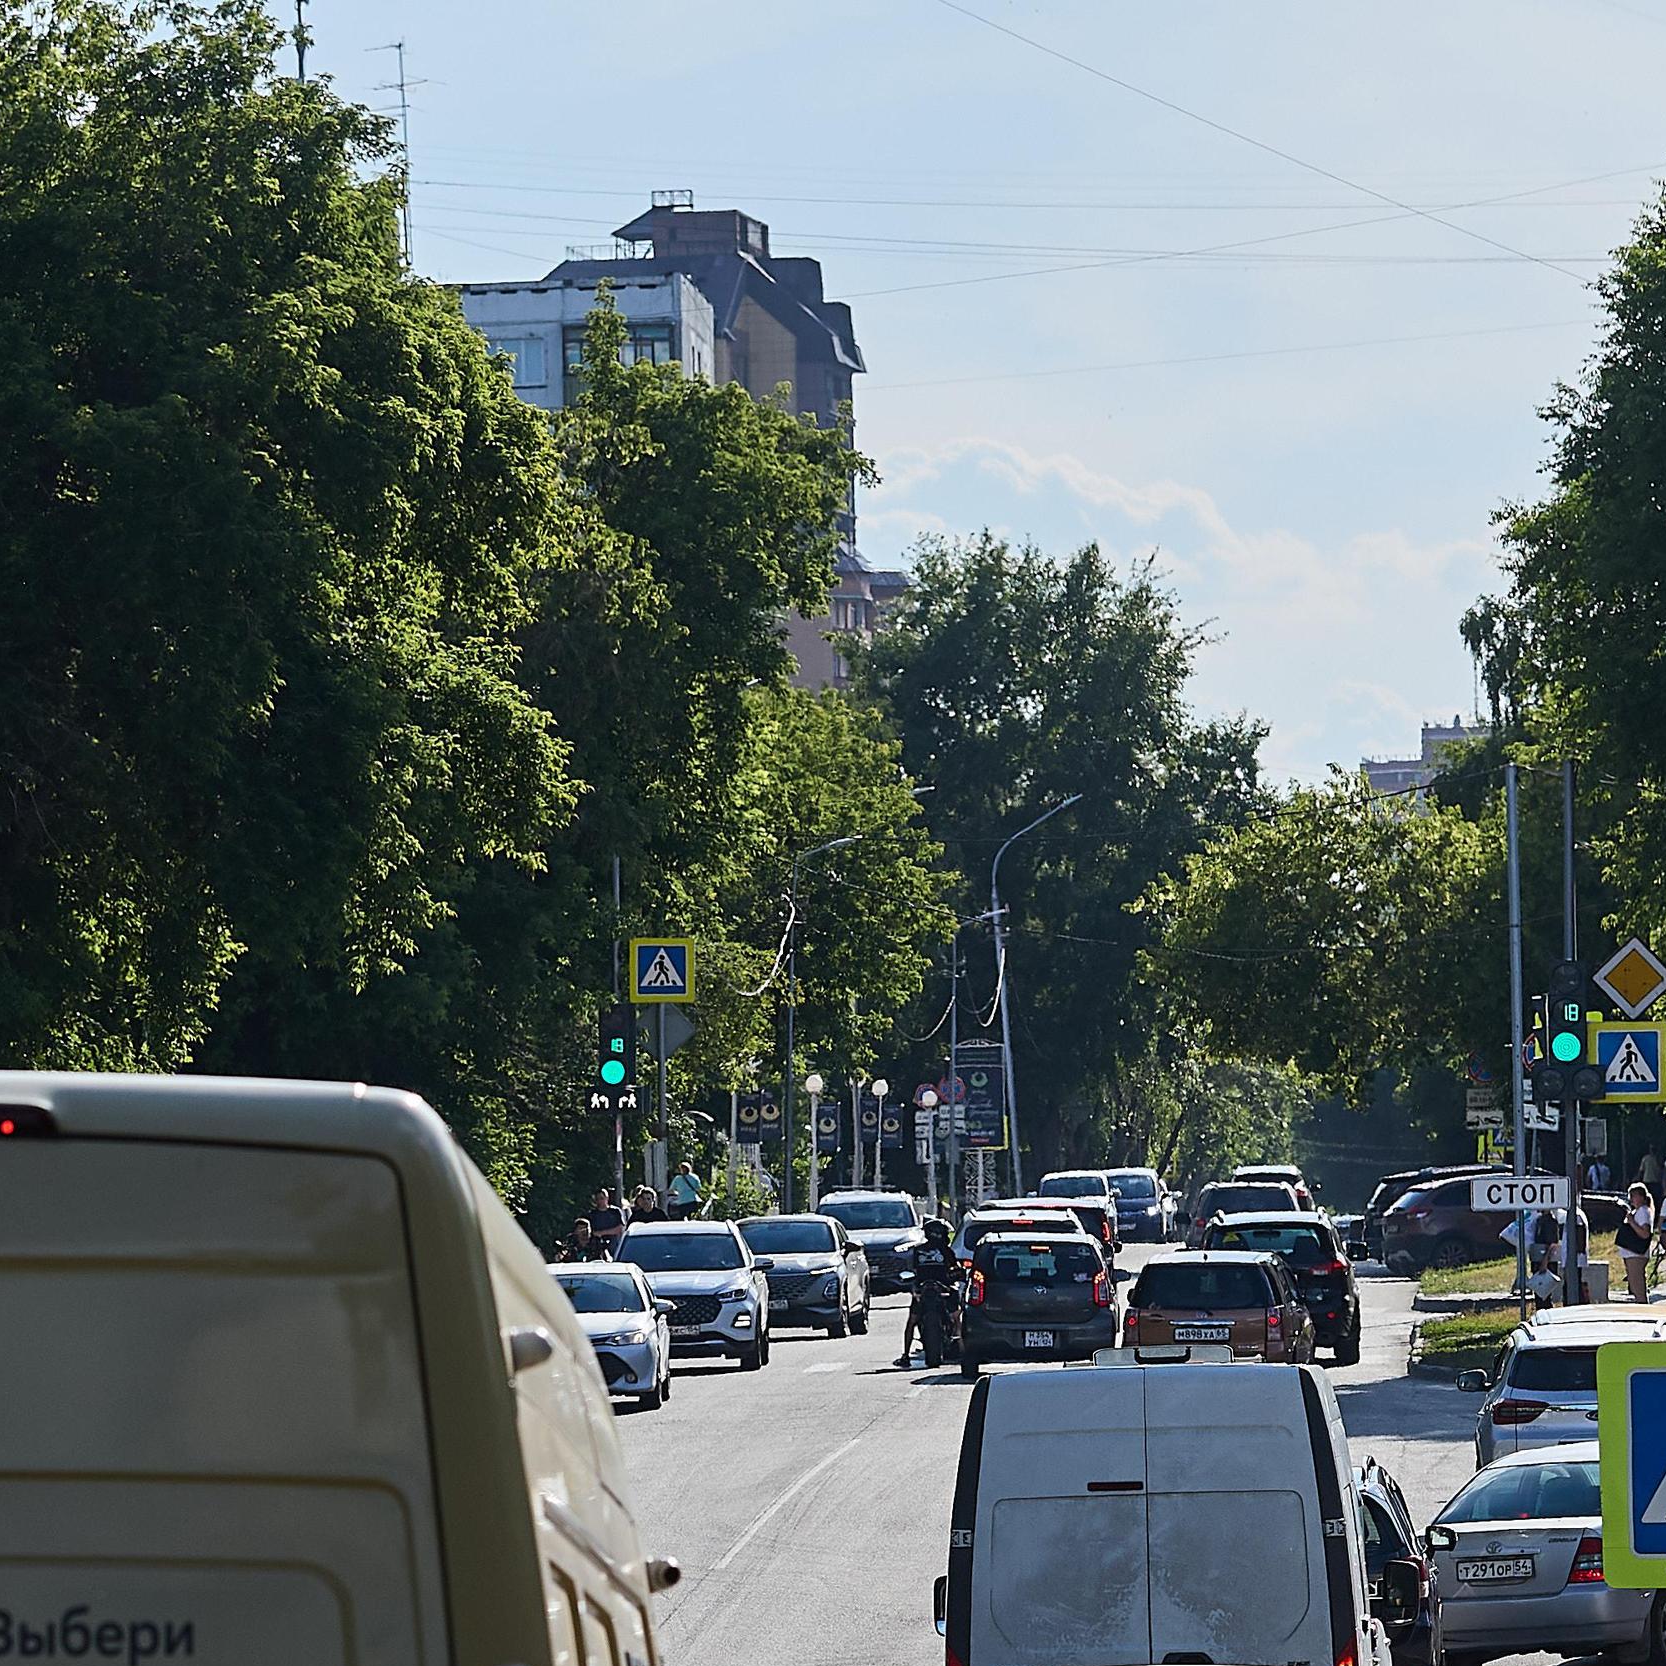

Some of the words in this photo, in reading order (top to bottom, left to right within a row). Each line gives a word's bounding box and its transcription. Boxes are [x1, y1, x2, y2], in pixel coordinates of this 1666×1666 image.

[1565, 1004, 1578, 1021] 18
[1487, 1183, 1555, 1204] СТОП
[1463, 1562, 1512, 1578] Т291ОР
[1515, 1560, 1528, 1571] 54
